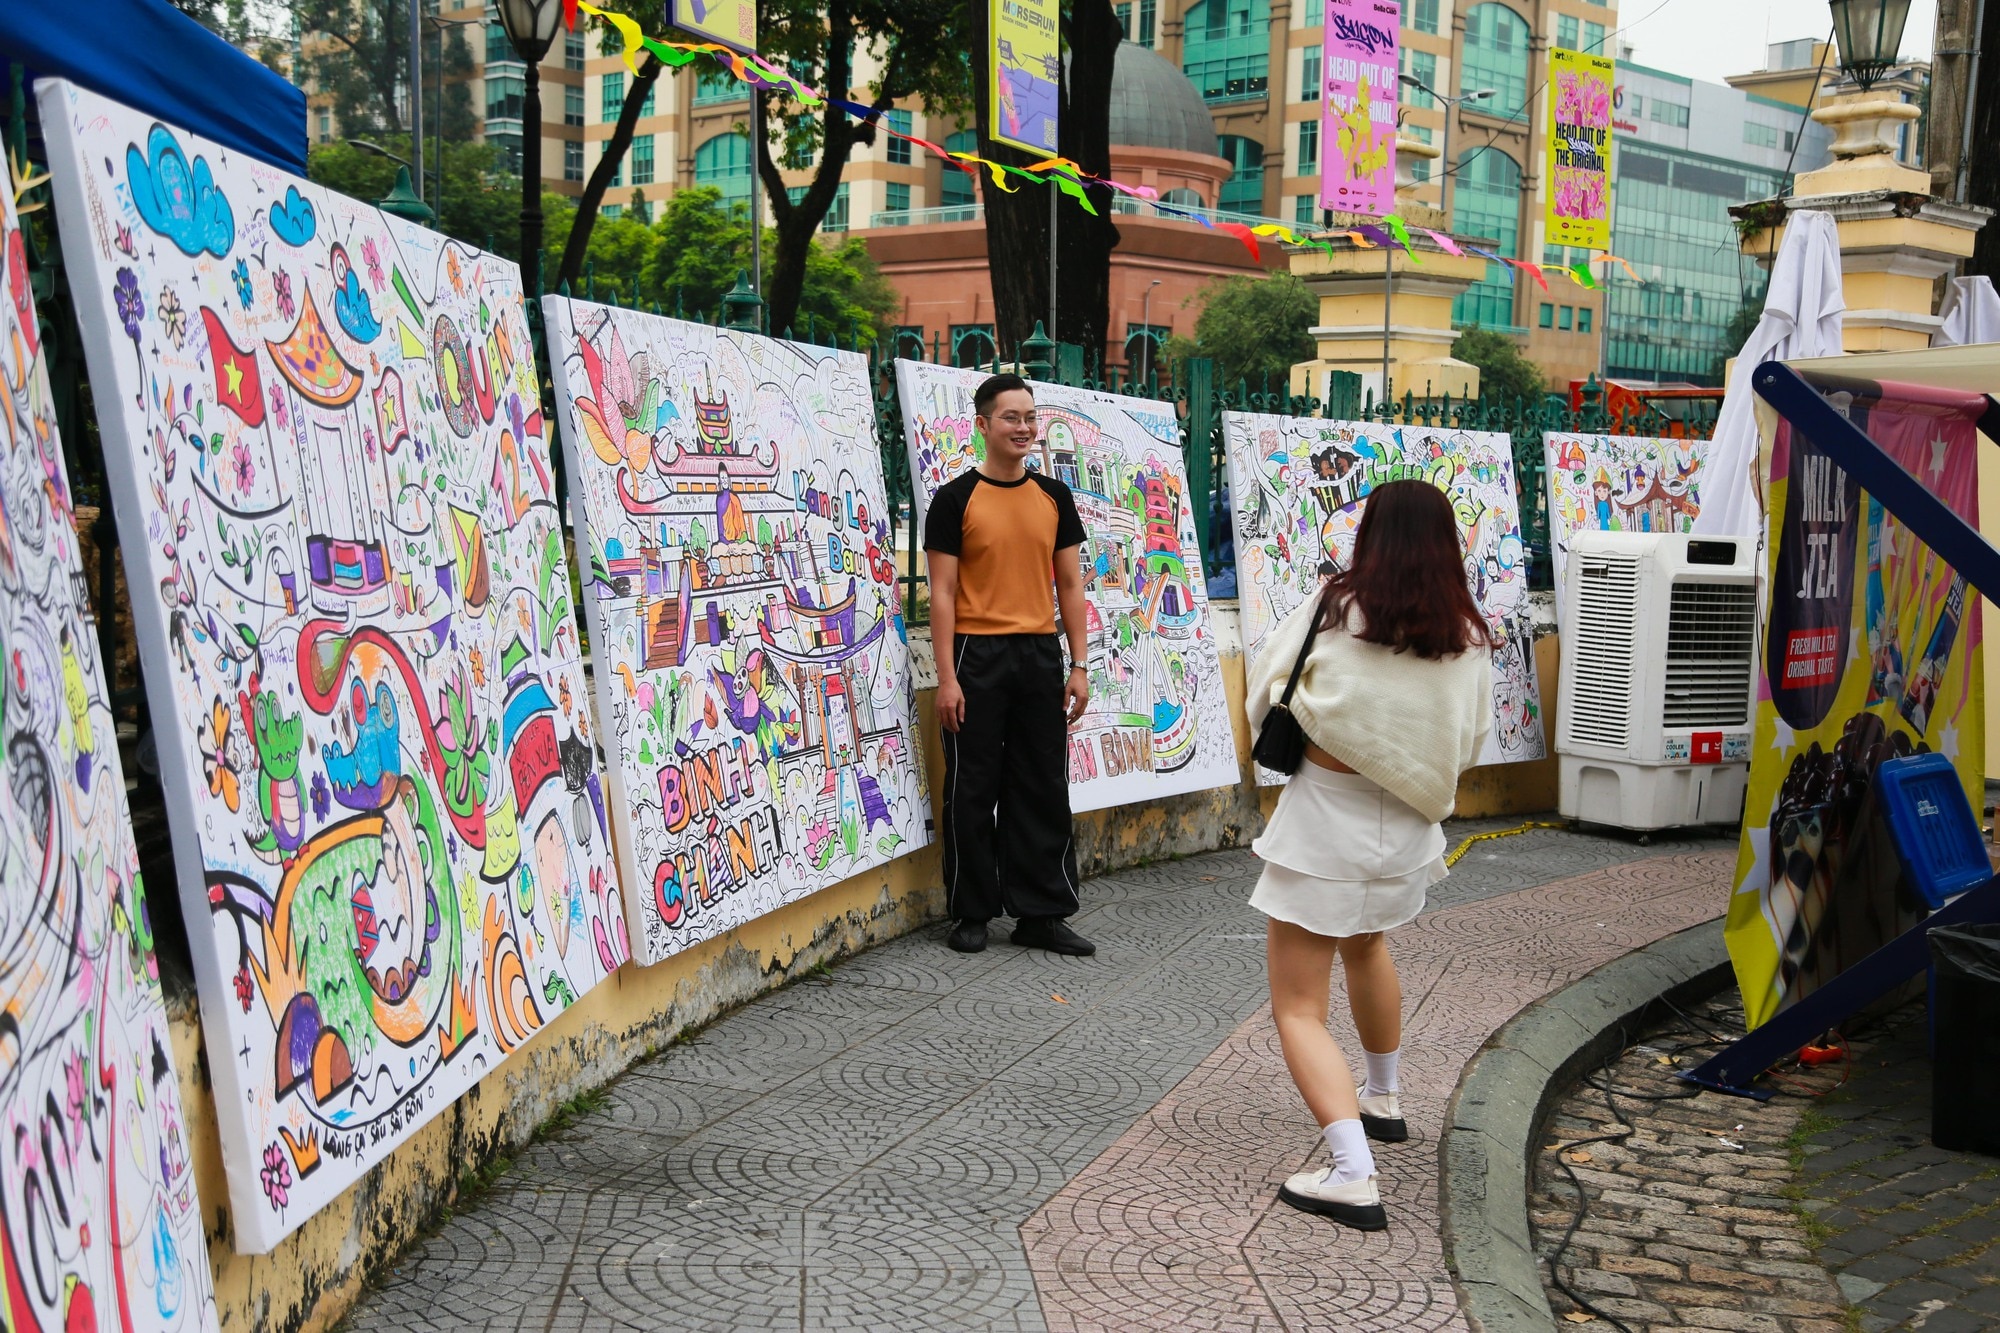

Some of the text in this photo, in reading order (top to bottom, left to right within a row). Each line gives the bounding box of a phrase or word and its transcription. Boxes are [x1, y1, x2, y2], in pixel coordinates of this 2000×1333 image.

[1328, 56, 1395, 90] HEAD OUT OF
[1555, 122, 1606, 147] HEAD OUT OF
[1555, 149, 1605, 172] THE ORIGINAL
[793, 470, 843, 532] Láng
[1803, 454, 1847, 522] MILK
[265, 531, 278, 544] LOVE
[827, 532, 866, 580] Bàu
[1796, 533, 1838, 599] TEA
[1790, 634, 1836, 655] FRESH MILK TEA
[1787, 657, 1834, 679] ORIGINAL TASTE
[1068, 735, 1098, 785] ÂN
[1100, 728, 1154, 778] BÌNH
[657, 737, 755, 836] BÌNH
[653, 806, 784, 930] CHÁNH
[323, 1127, 352, 1160] LÀNG
